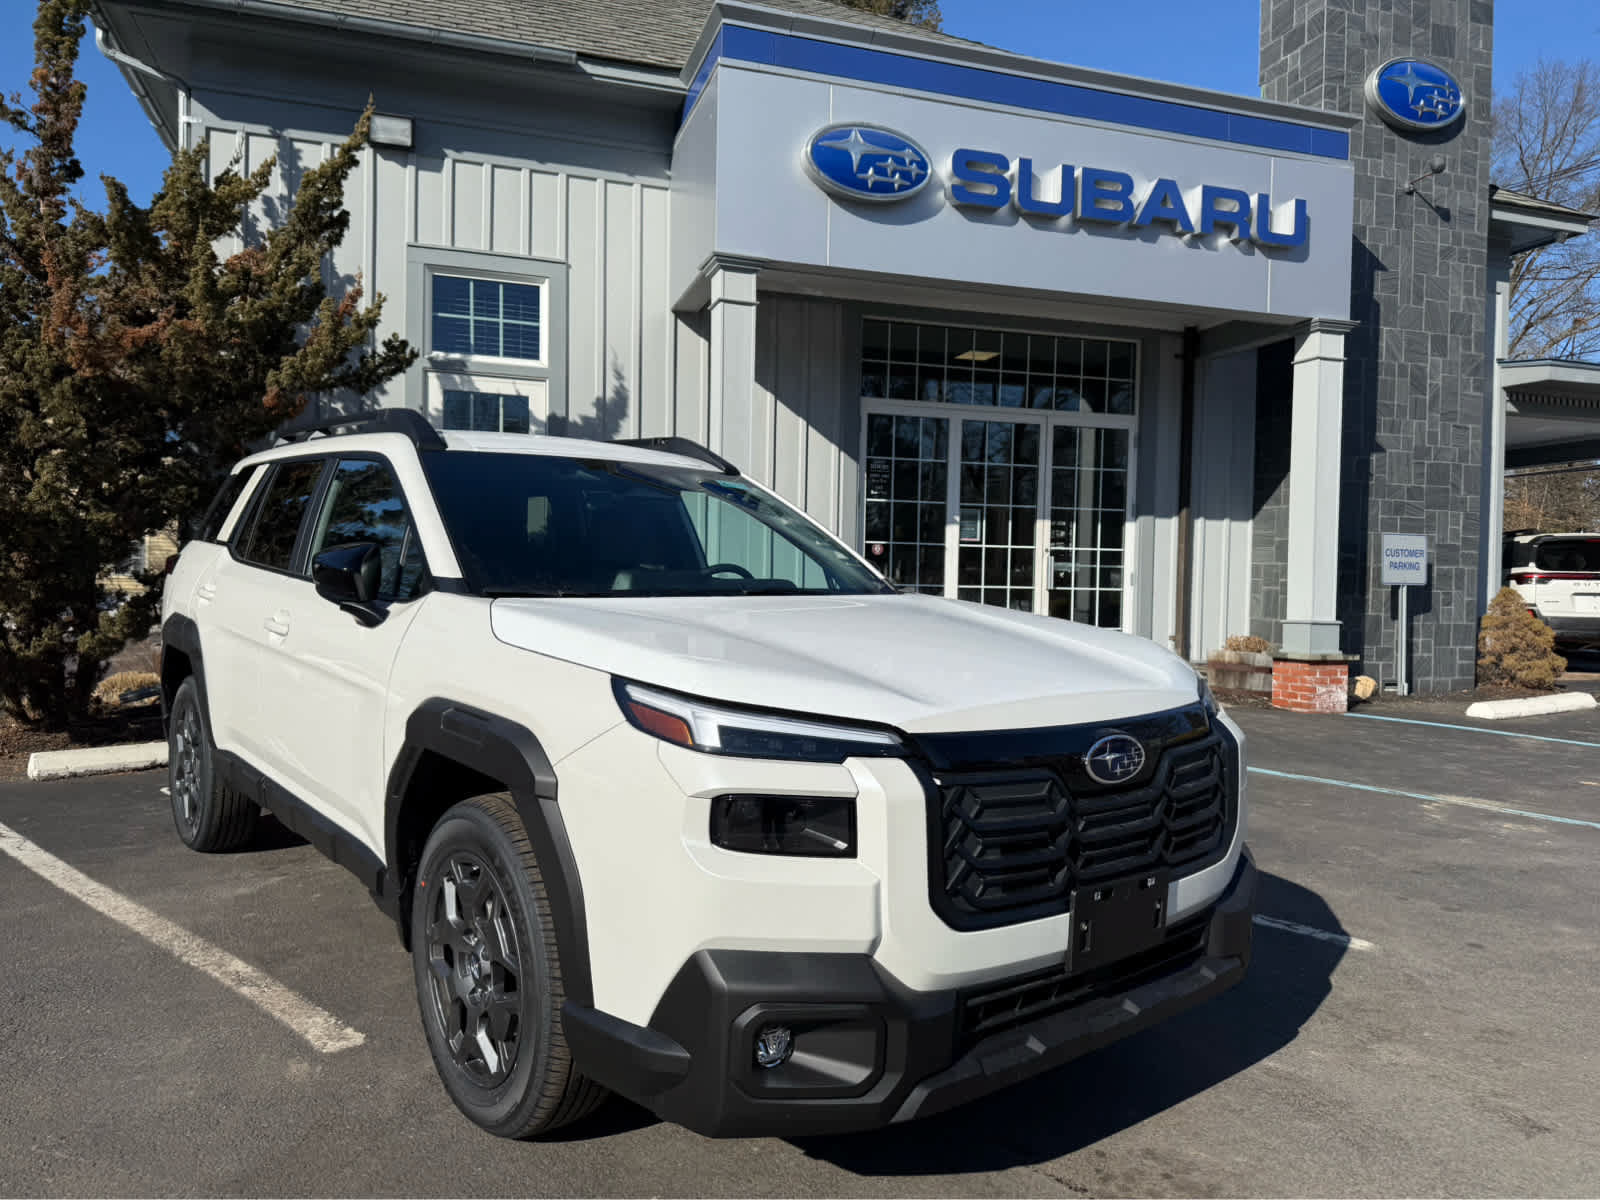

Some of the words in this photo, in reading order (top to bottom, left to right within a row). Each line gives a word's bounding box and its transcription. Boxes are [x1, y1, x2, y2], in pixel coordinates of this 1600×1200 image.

[951, 148, 1307, 247] SUBARU
[1385, 548, 1425, 558] CUSTOMER
[1389, 560, 1421, 571] PARKING
